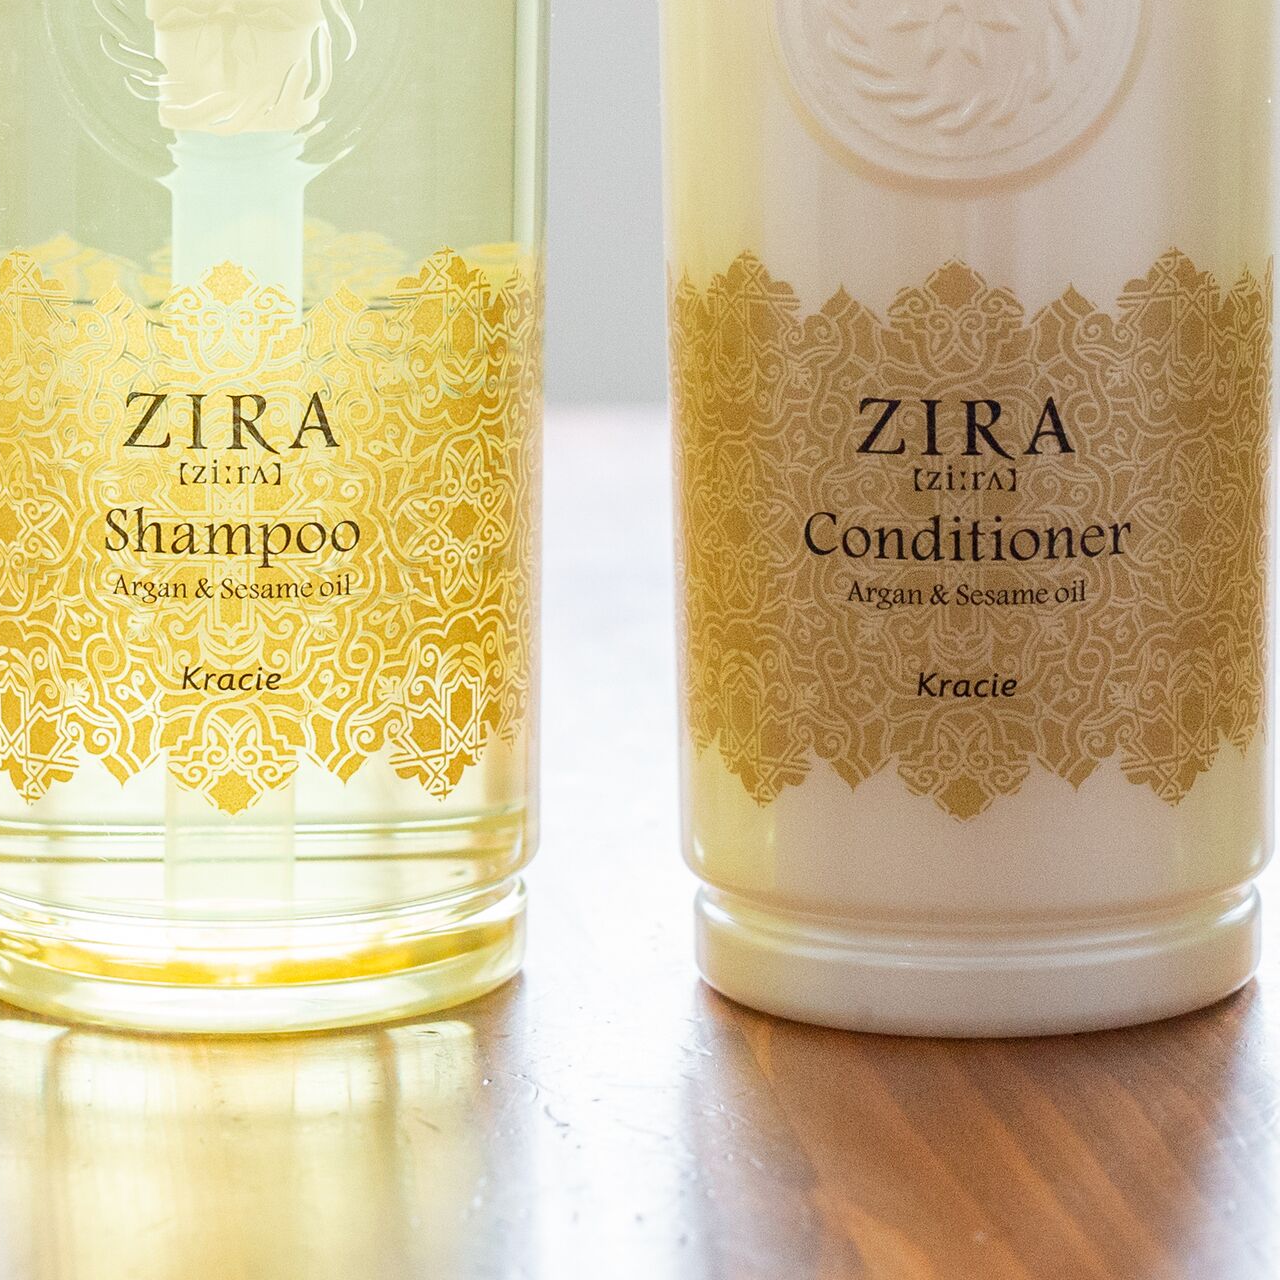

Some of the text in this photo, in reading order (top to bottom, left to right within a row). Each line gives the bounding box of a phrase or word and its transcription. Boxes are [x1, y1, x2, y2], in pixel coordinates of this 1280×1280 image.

[122, 391, 341, 455] ZIRA
[855, 395, 1076, 461] ZIRA
[104, 506, 361, 569] Shampoo
[803, 511, 1132, 562] Conditioner
[112, 574, 352, 603] Argan & Sesame oil
[847, 579, 1086, 610] Argan & Sesame oil
[182, 666, 282, 691] Kracie
[916, 671, 1018, 698] Kracie
